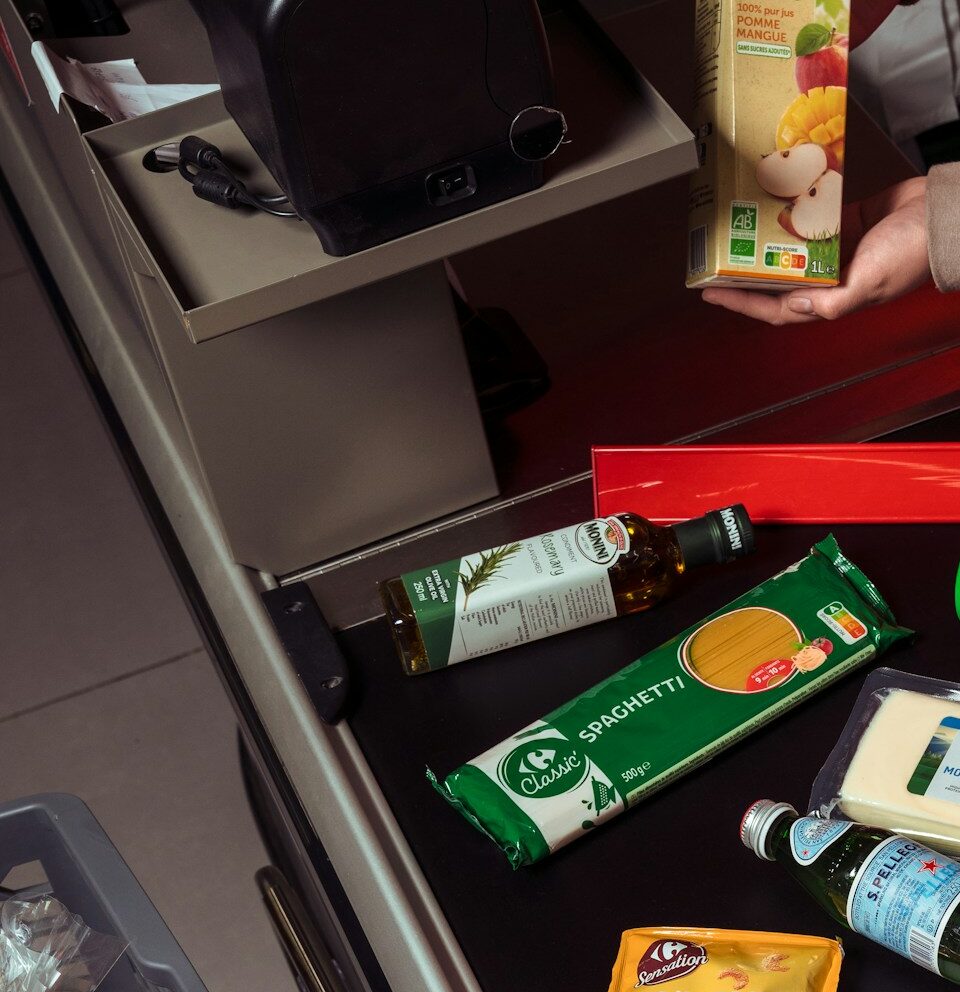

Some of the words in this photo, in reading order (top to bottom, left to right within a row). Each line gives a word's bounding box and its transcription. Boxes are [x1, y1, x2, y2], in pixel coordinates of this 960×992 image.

[736, 15, 780, 30] POMME
[737, 3, 763, 14] 100%
[763, 8, 779, 17] pur
[780, 8, 794, 18] jus
[736, 28, 787, 43] MANGUE
[737, 44, 750, 52] SANS
[750, 45, 767, 54] SUCRES
[811, 261, 825, 274] 1L
[584, 522, 609, 560] MONINI
[720, 507, 743, 550] MONINI
[527, 544, 543, 574] FLAVOURED
[541, 533, 564, 576] Rosemary
[560, 534, 577, 563] CONDIMENT
[413, 582, 424, 595] 250
[420, 593, 428, 602] ml
[425, 577, 435, 592] OLIVE
[430, 591, 438, 600] OIL
[432, 570, 441, 586] EXTRA
[438, 584, 449, 603] VIRGIN
[768, 667, 779, 676] 10
[578, 675, 685, 744] SPAGHETTI
[634, 952, 708, 988] Sensation
